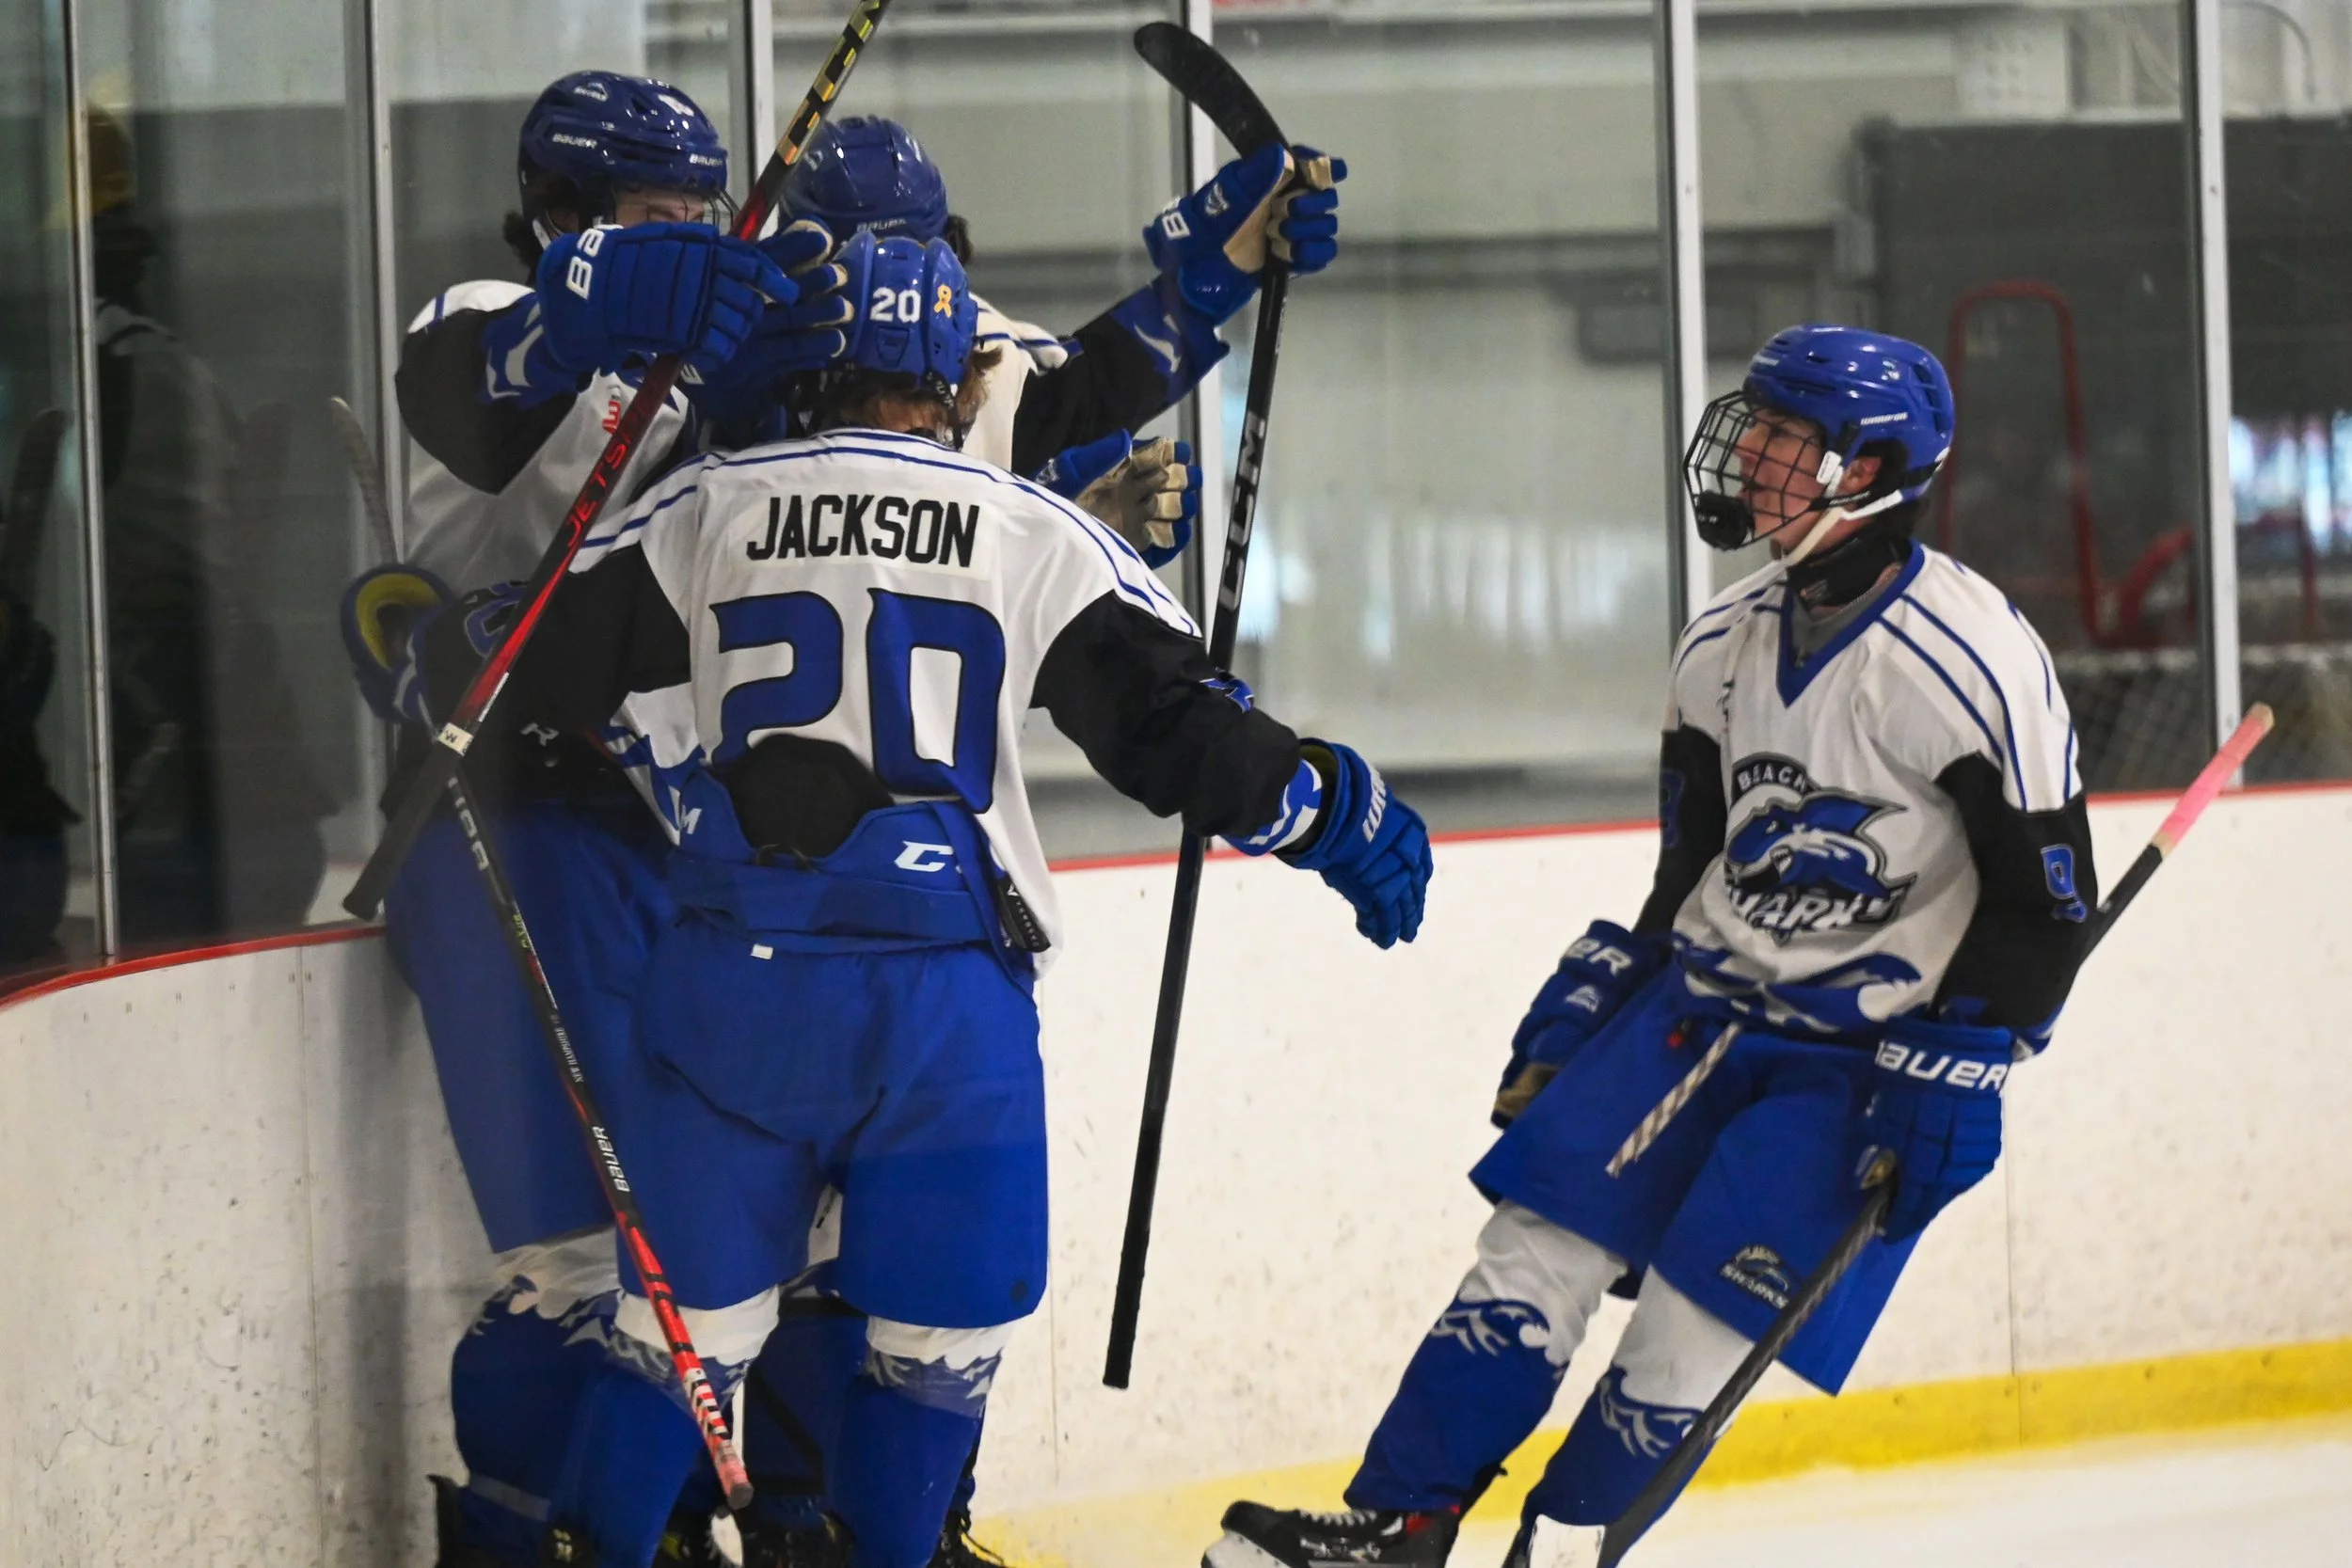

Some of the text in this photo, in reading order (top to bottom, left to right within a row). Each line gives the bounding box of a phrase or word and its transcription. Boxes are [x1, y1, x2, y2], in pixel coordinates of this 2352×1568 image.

[869, 287, 921, 323] 20
[747, 494, 979, 567] JACKSON
[709, 588, 1006, 814] 20
[1875, 1039, 2010, 1090] AUER
[591, 1126, 630, 1193] BAUER
